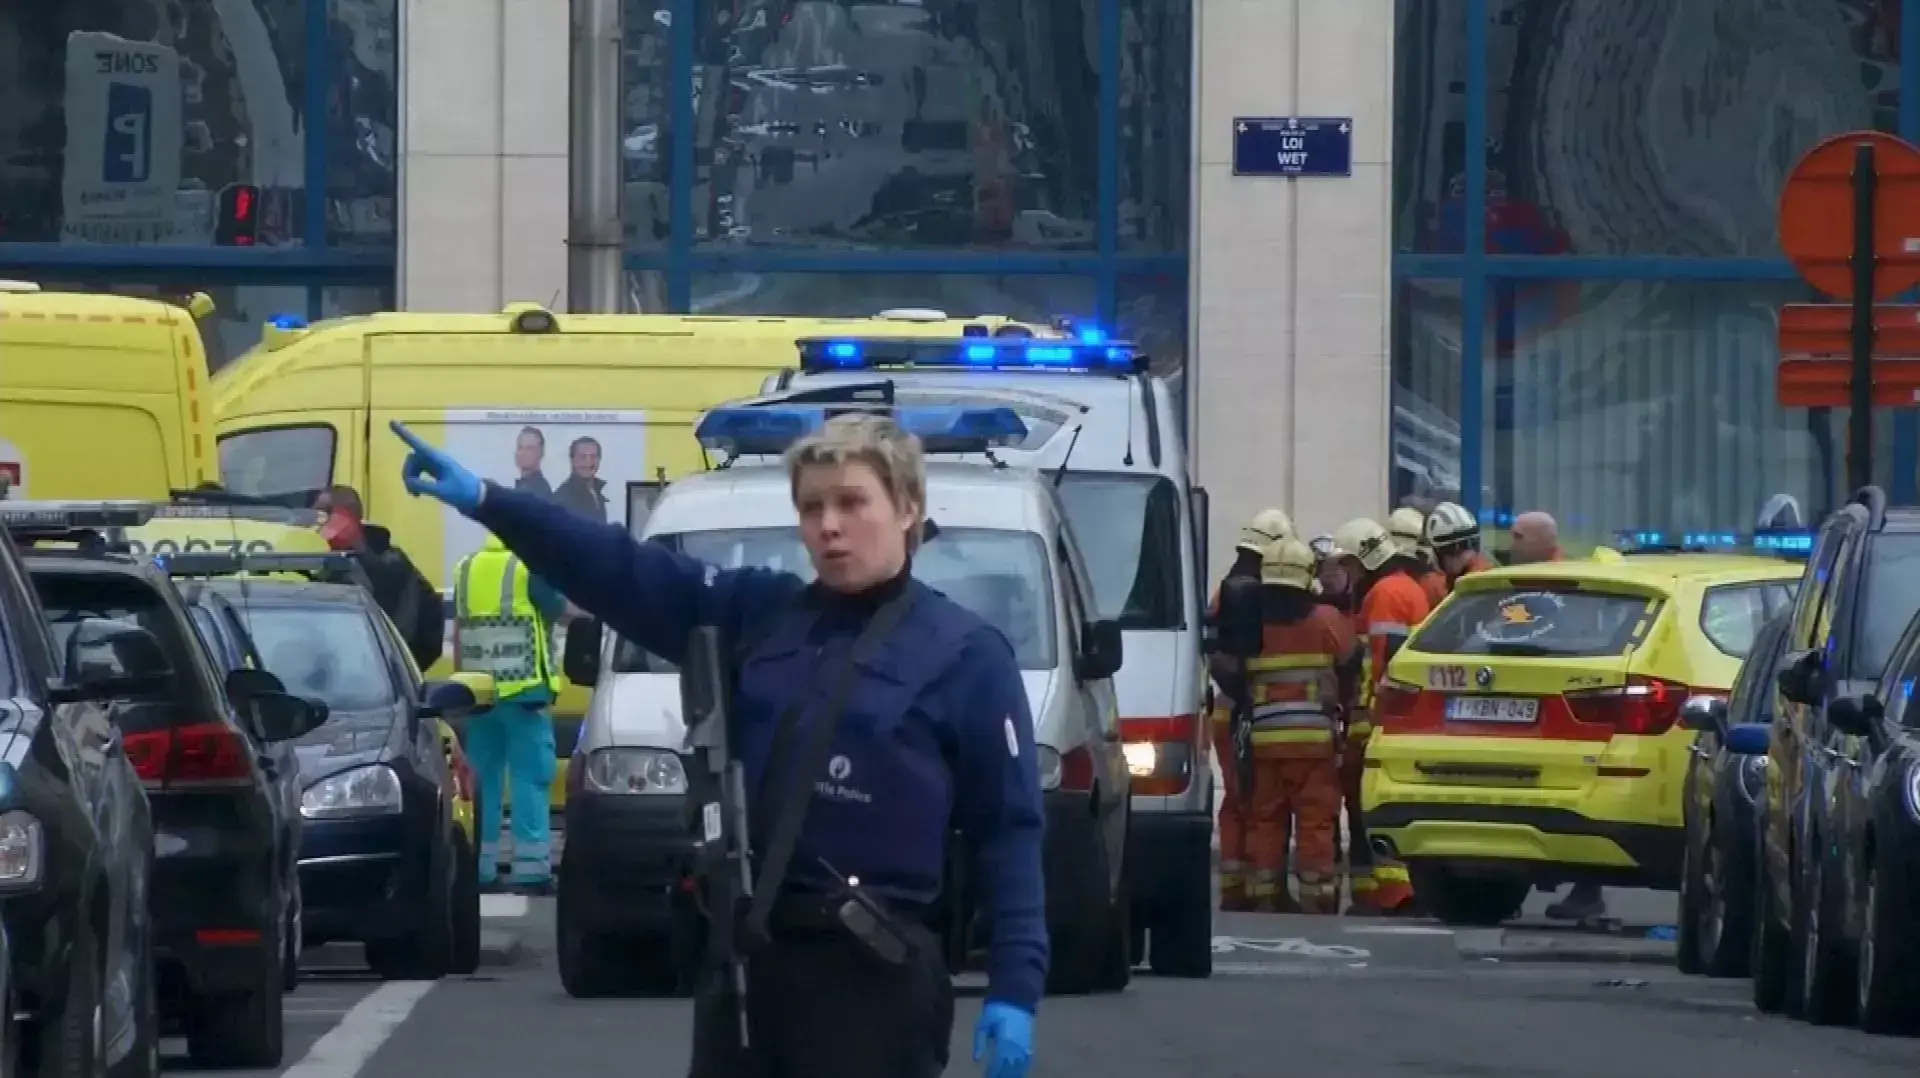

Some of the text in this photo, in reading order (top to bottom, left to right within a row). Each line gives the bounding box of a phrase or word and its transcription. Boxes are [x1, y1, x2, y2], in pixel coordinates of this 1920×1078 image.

[1281, 137, 1304, 150] LOI
[1276, 151, 1308, 165] WET
[1440, 665, 1467, 687] 112
